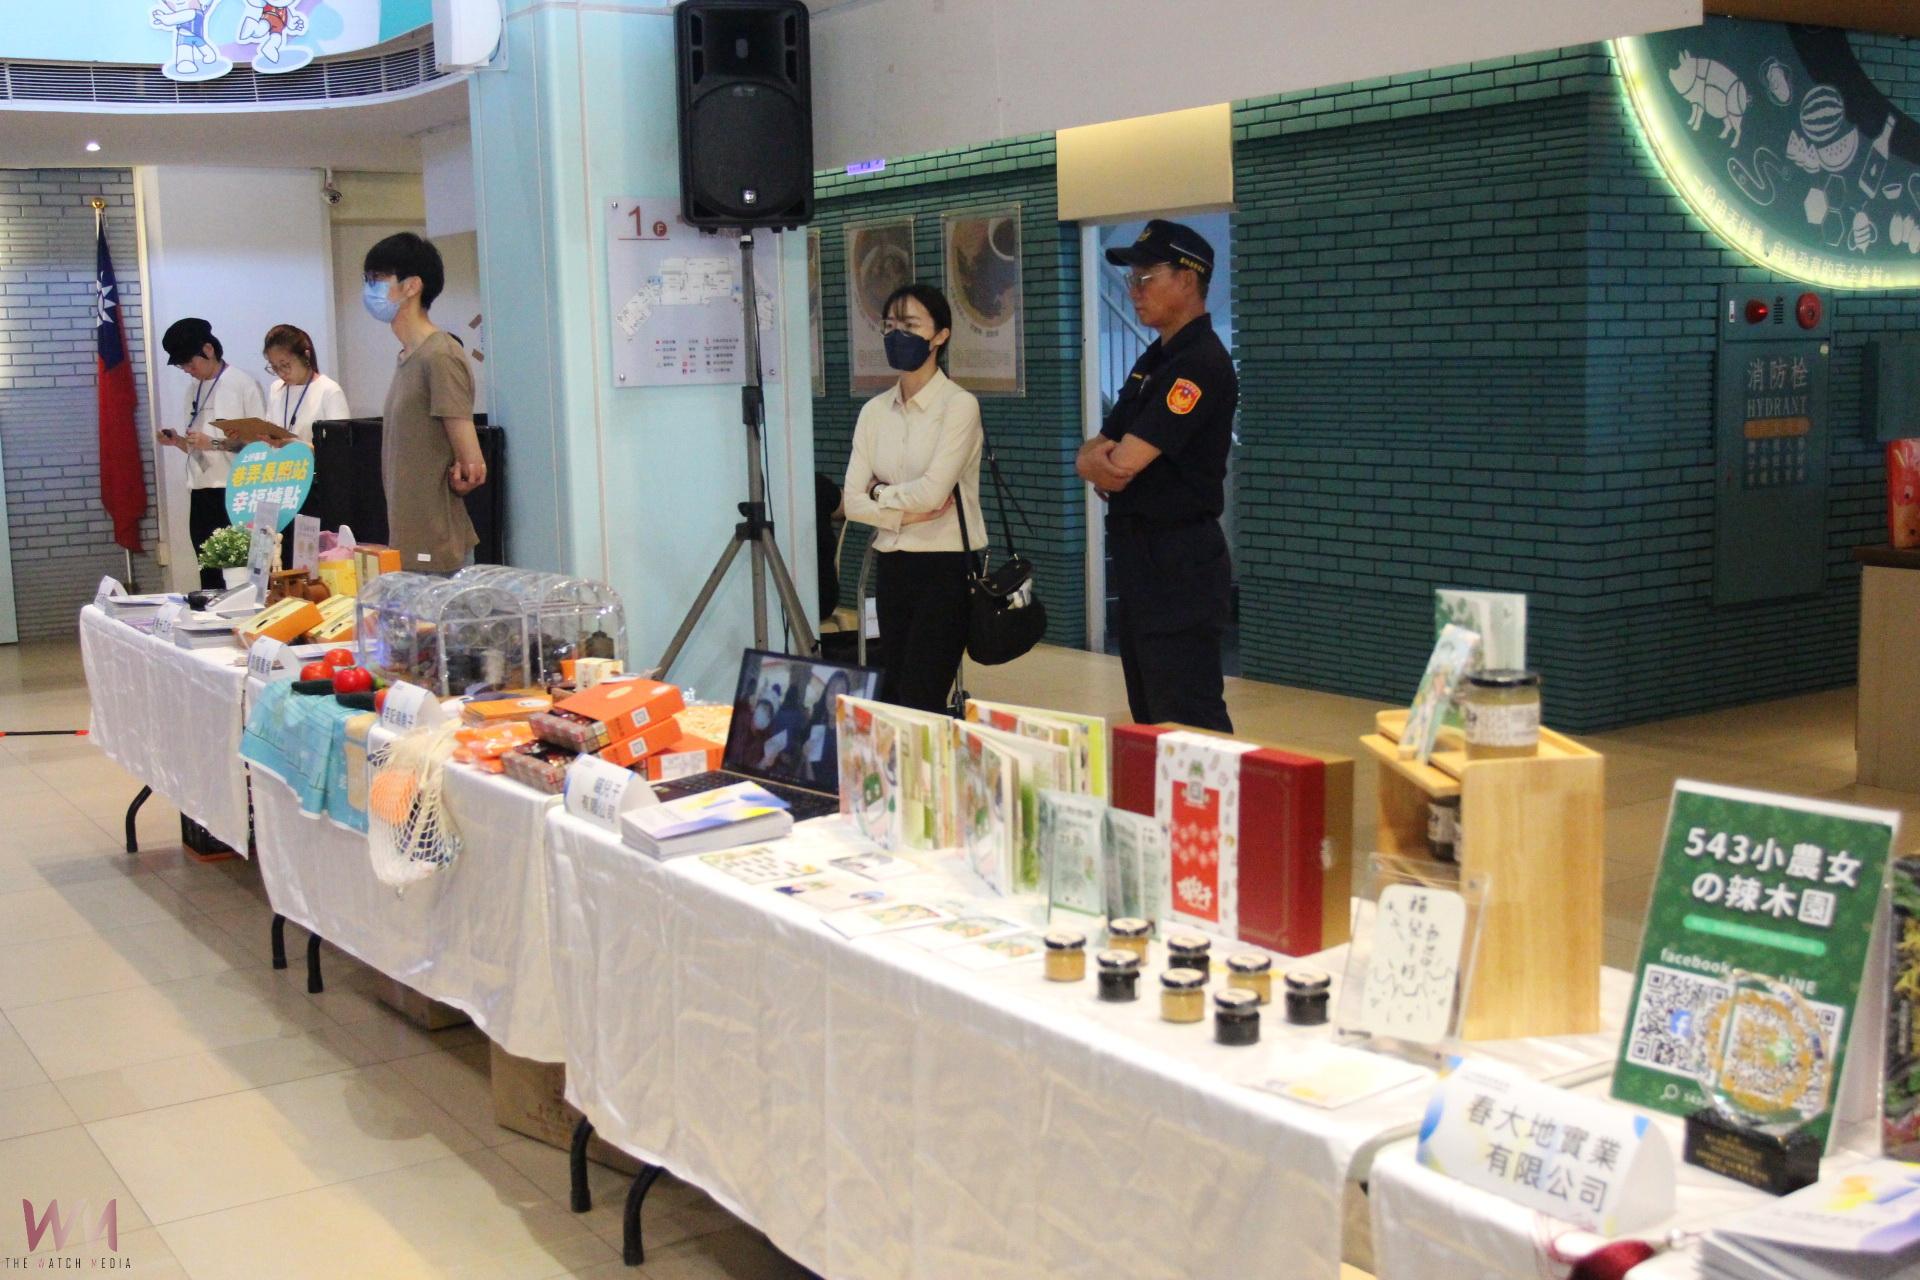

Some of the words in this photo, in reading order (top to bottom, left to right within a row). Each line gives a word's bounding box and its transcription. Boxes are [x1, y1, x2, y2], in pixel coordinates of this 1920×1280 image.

[628, 205, 643, 237] 1
[1748, 356, 1808, 391] 消防栓
[1747, 396, 1808, 418] HYDRANT
[1684, 827, 1861, 888] 543小農女
[1692, 872, 1837, 928] の辣木園
[1660, 947, 1732, 974] facebook
[1468, 1094, 1621, 1171] 春大地實業
[1485, 1142, 1607, 1213] 有限公司
